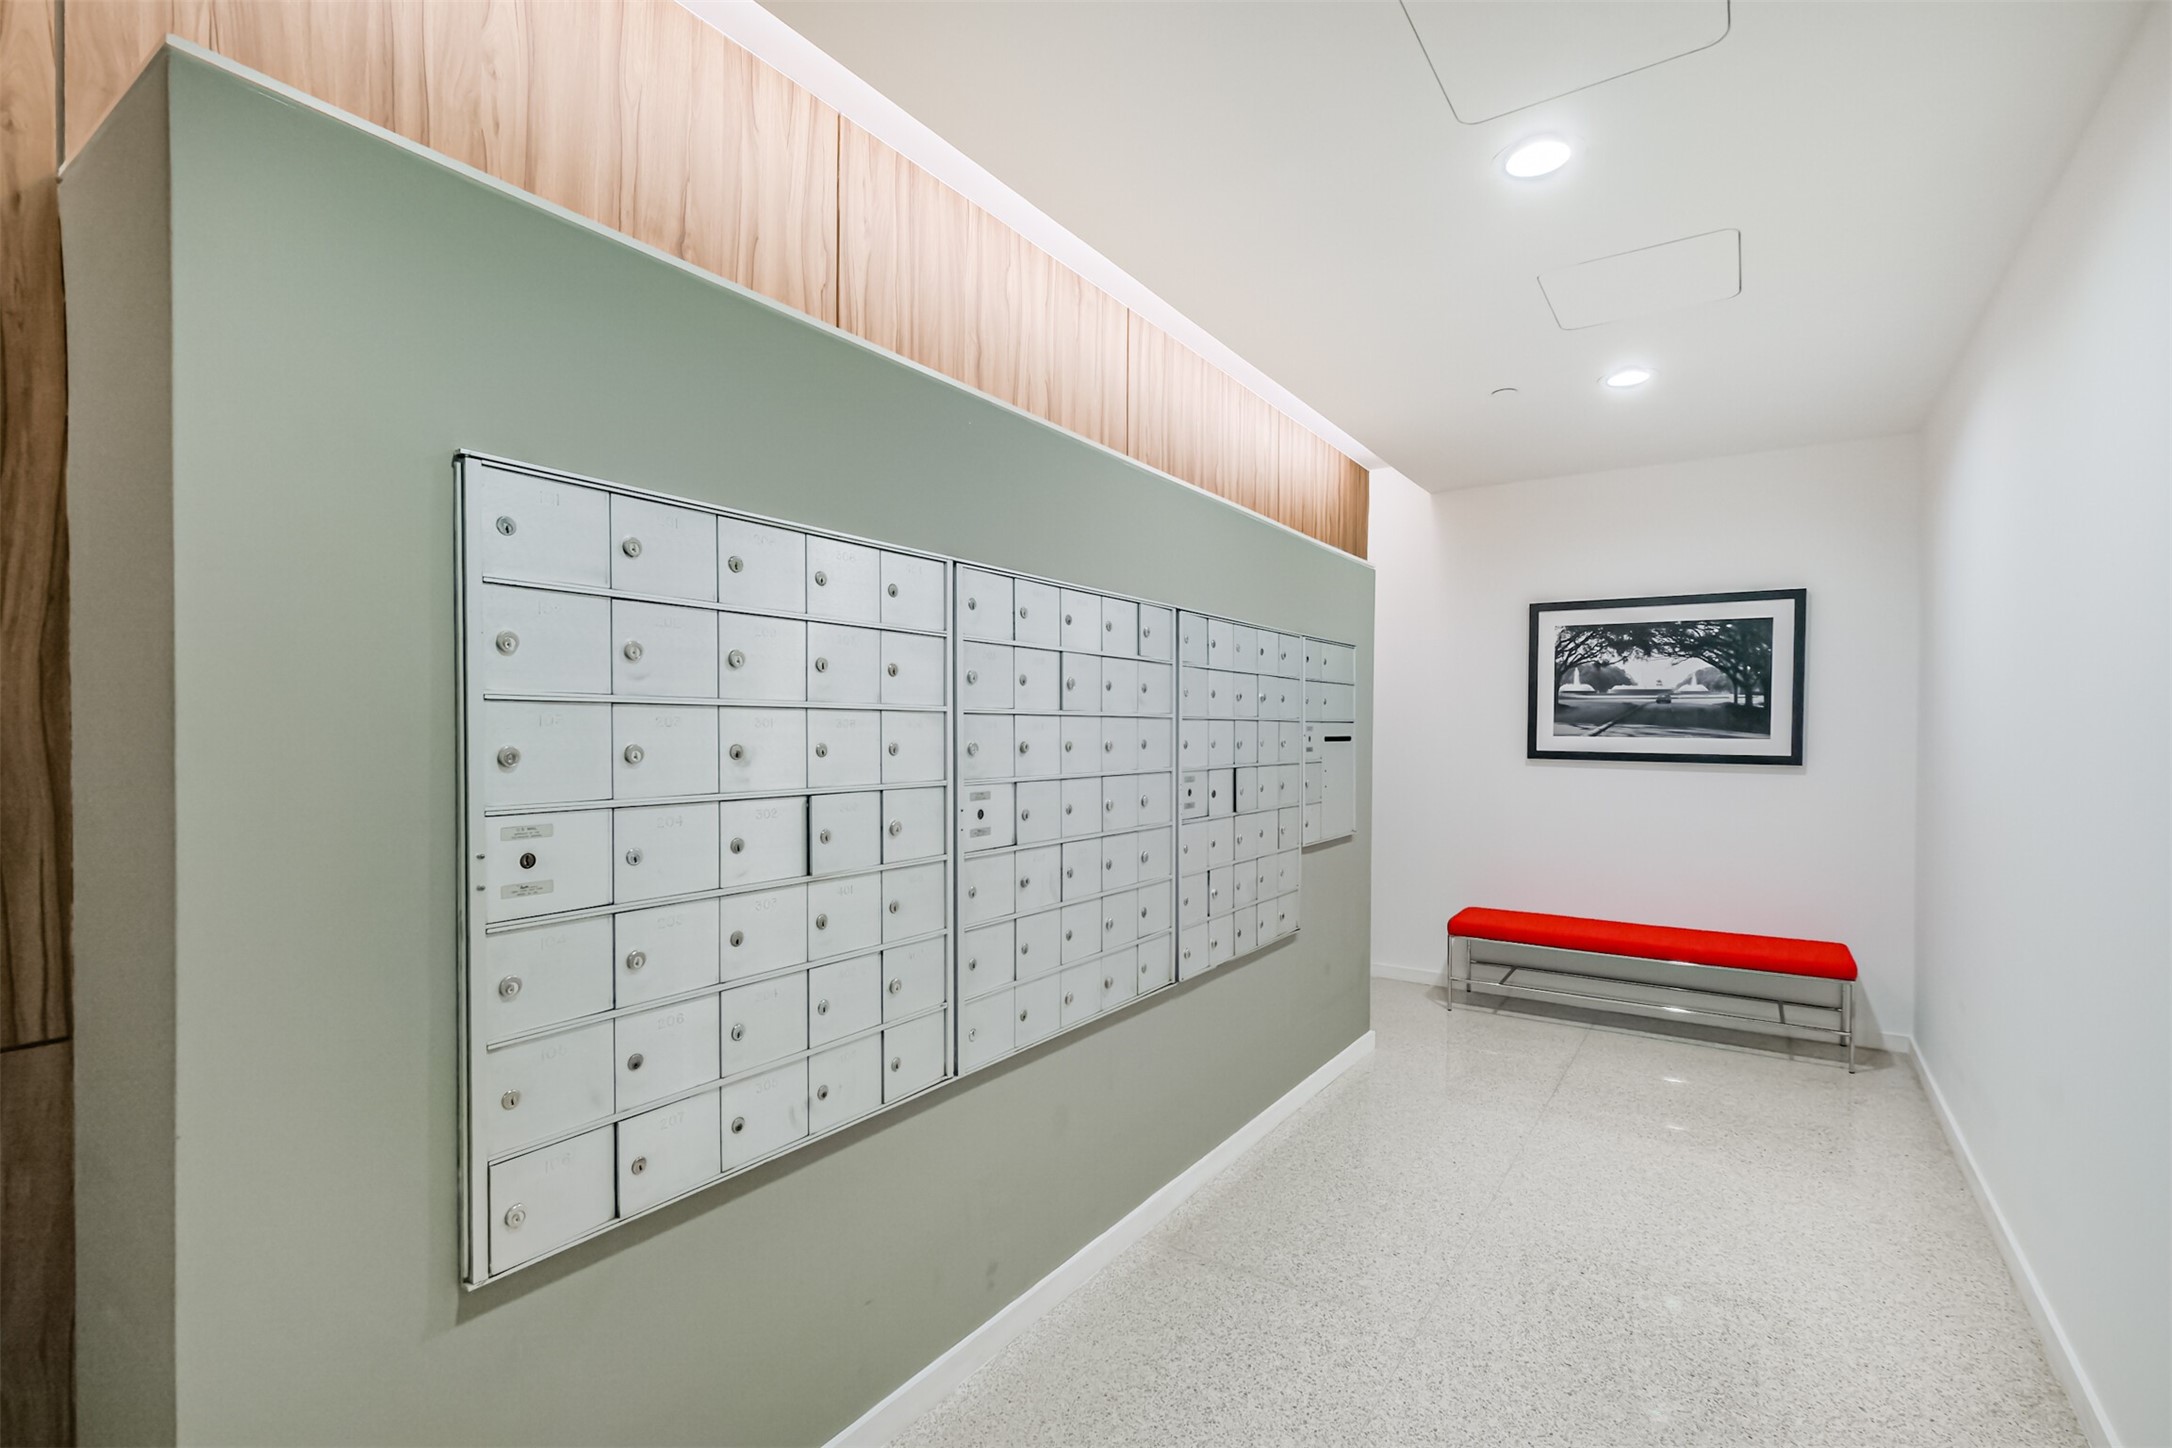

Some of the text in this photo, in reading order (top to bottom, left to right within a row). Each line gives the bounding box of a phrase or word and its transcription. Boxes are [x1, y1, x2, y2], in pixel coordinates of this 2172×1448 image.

[755, 807, 778, 820] 302
[656, 815, 683, 829] 204
[657, 1012, 685, 1030] 206
[660, 1111, 685, 1130] 207
